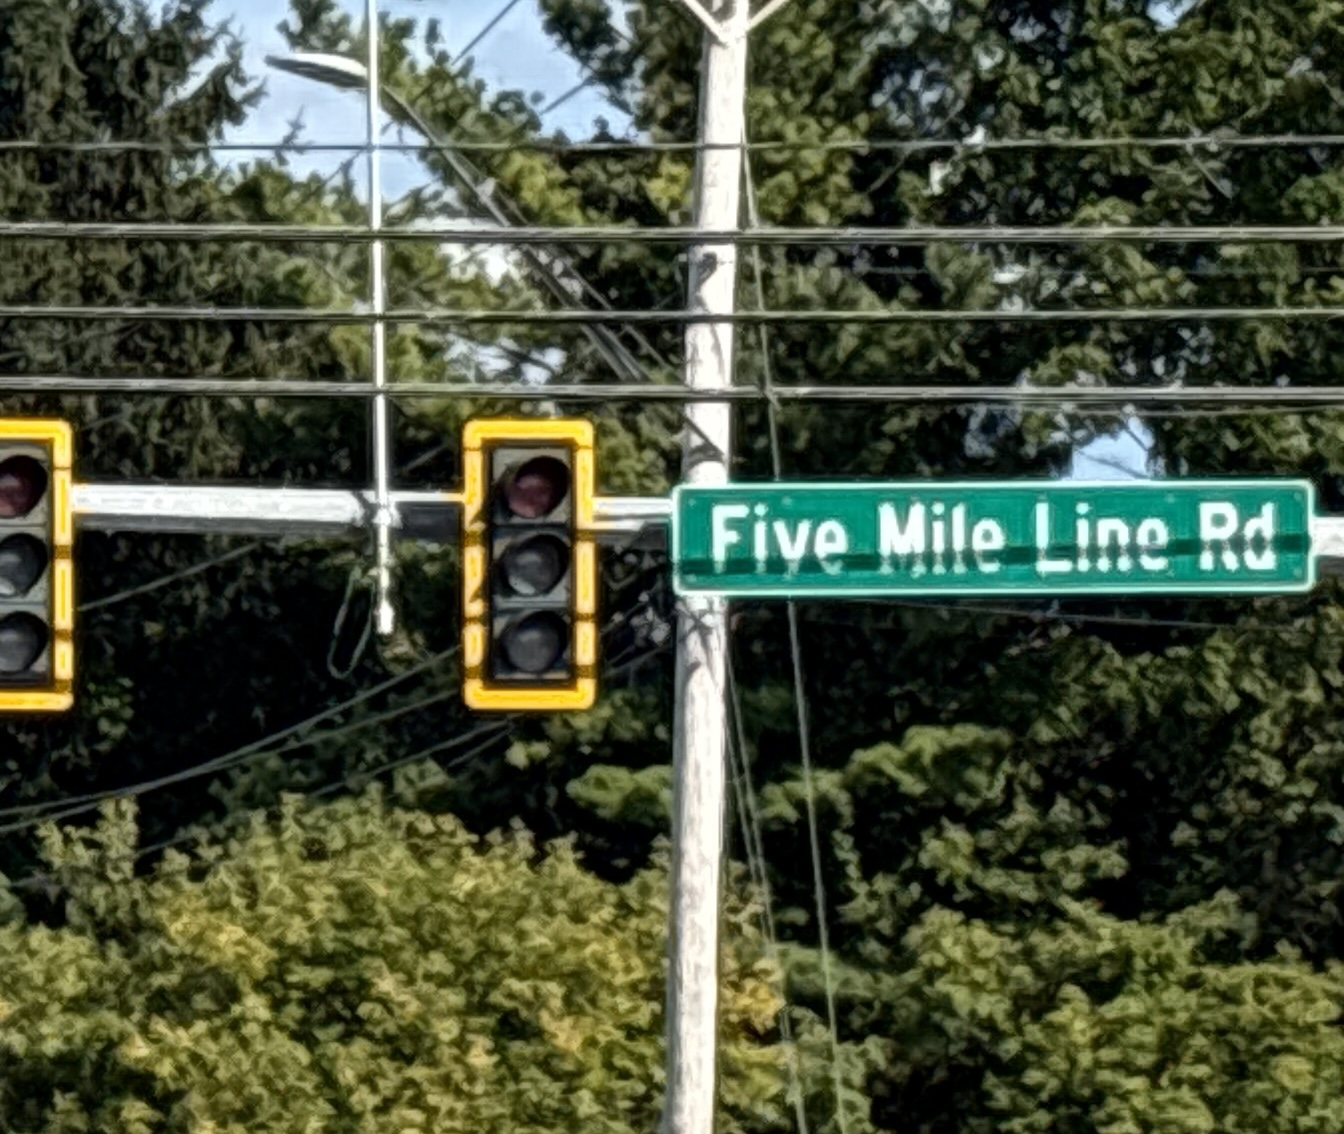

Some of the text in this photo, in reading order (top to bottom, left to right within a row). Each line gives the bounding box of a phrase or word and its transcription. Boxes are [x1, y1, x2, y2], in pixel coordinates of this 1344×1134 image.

[712, 501, 1276, 574] Five Mile Line Rd
